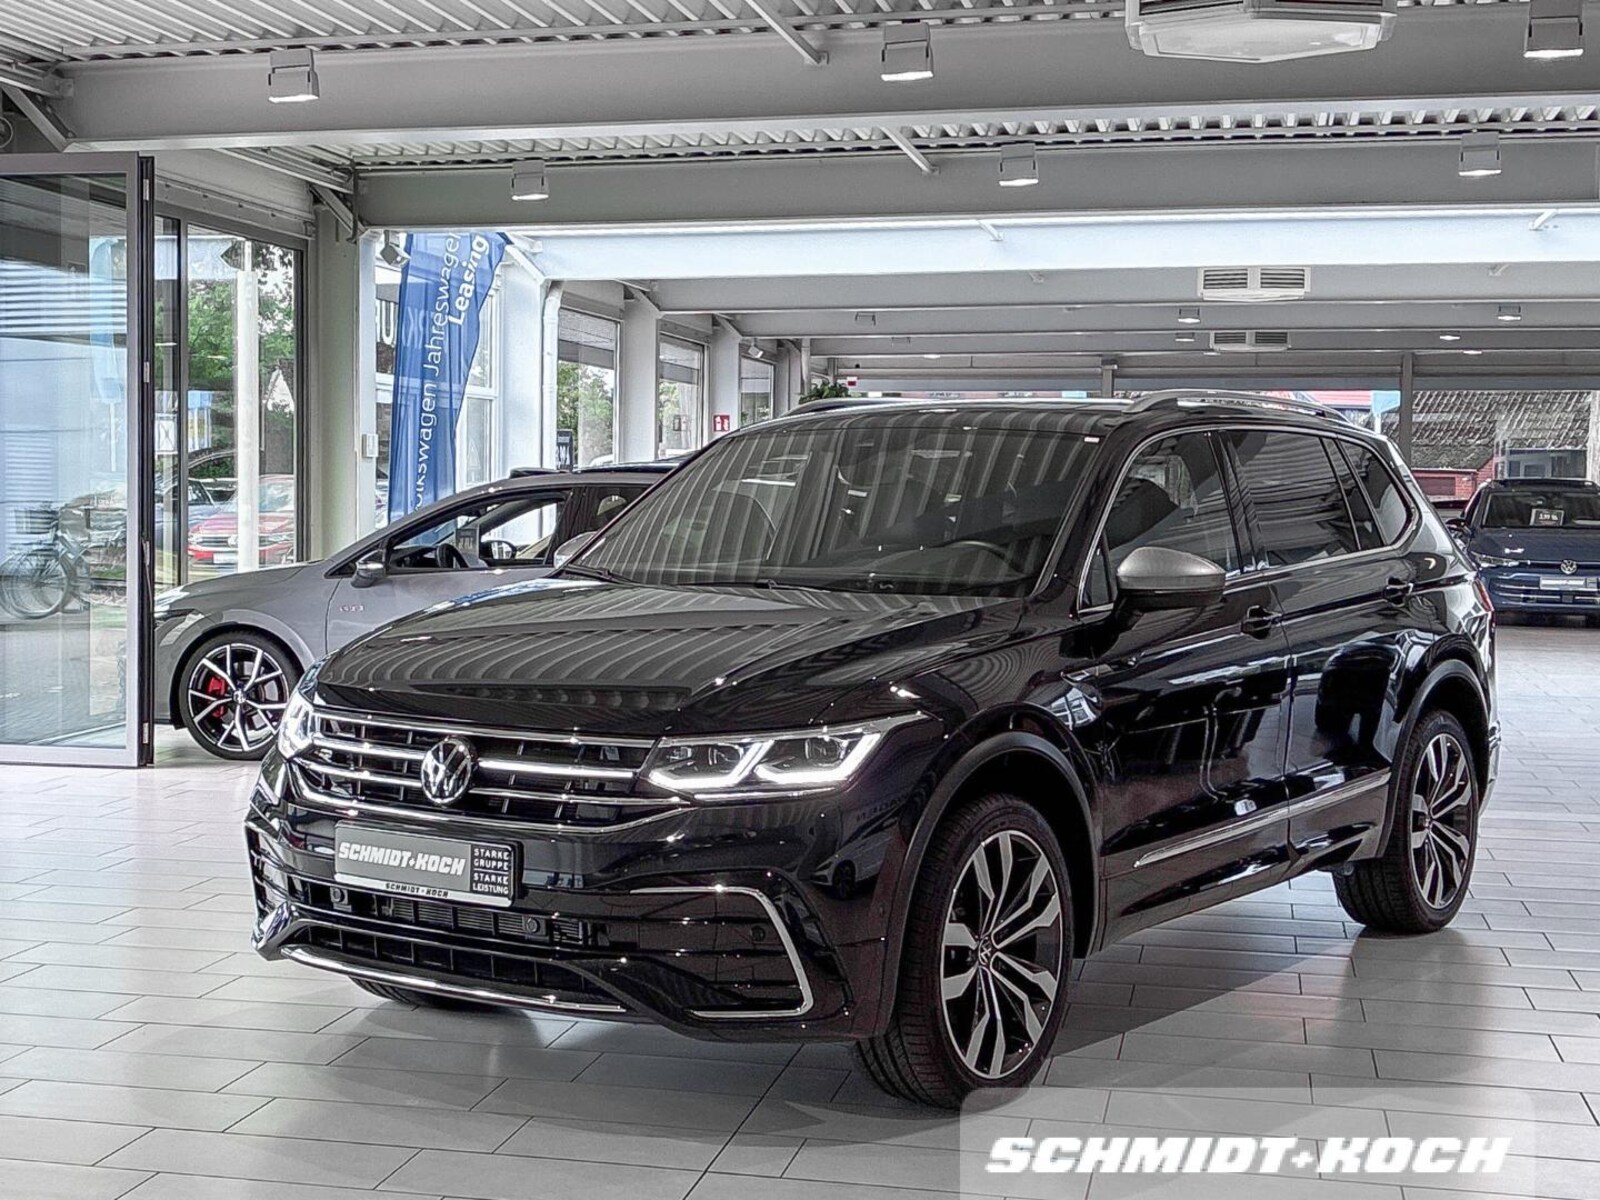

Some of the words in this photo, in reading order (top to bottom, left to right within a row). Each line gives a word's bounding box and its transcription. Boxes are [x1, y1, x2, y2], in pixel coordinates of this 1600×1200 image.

[448, 234, 490, 327] Leasing
[473, 848, 509, 860] STARKE
[473, 858, 509, 871] GRUPPE
[473, 872, 509, 885] STARKE
[472, 883, 509, 895] LEISTUNG
